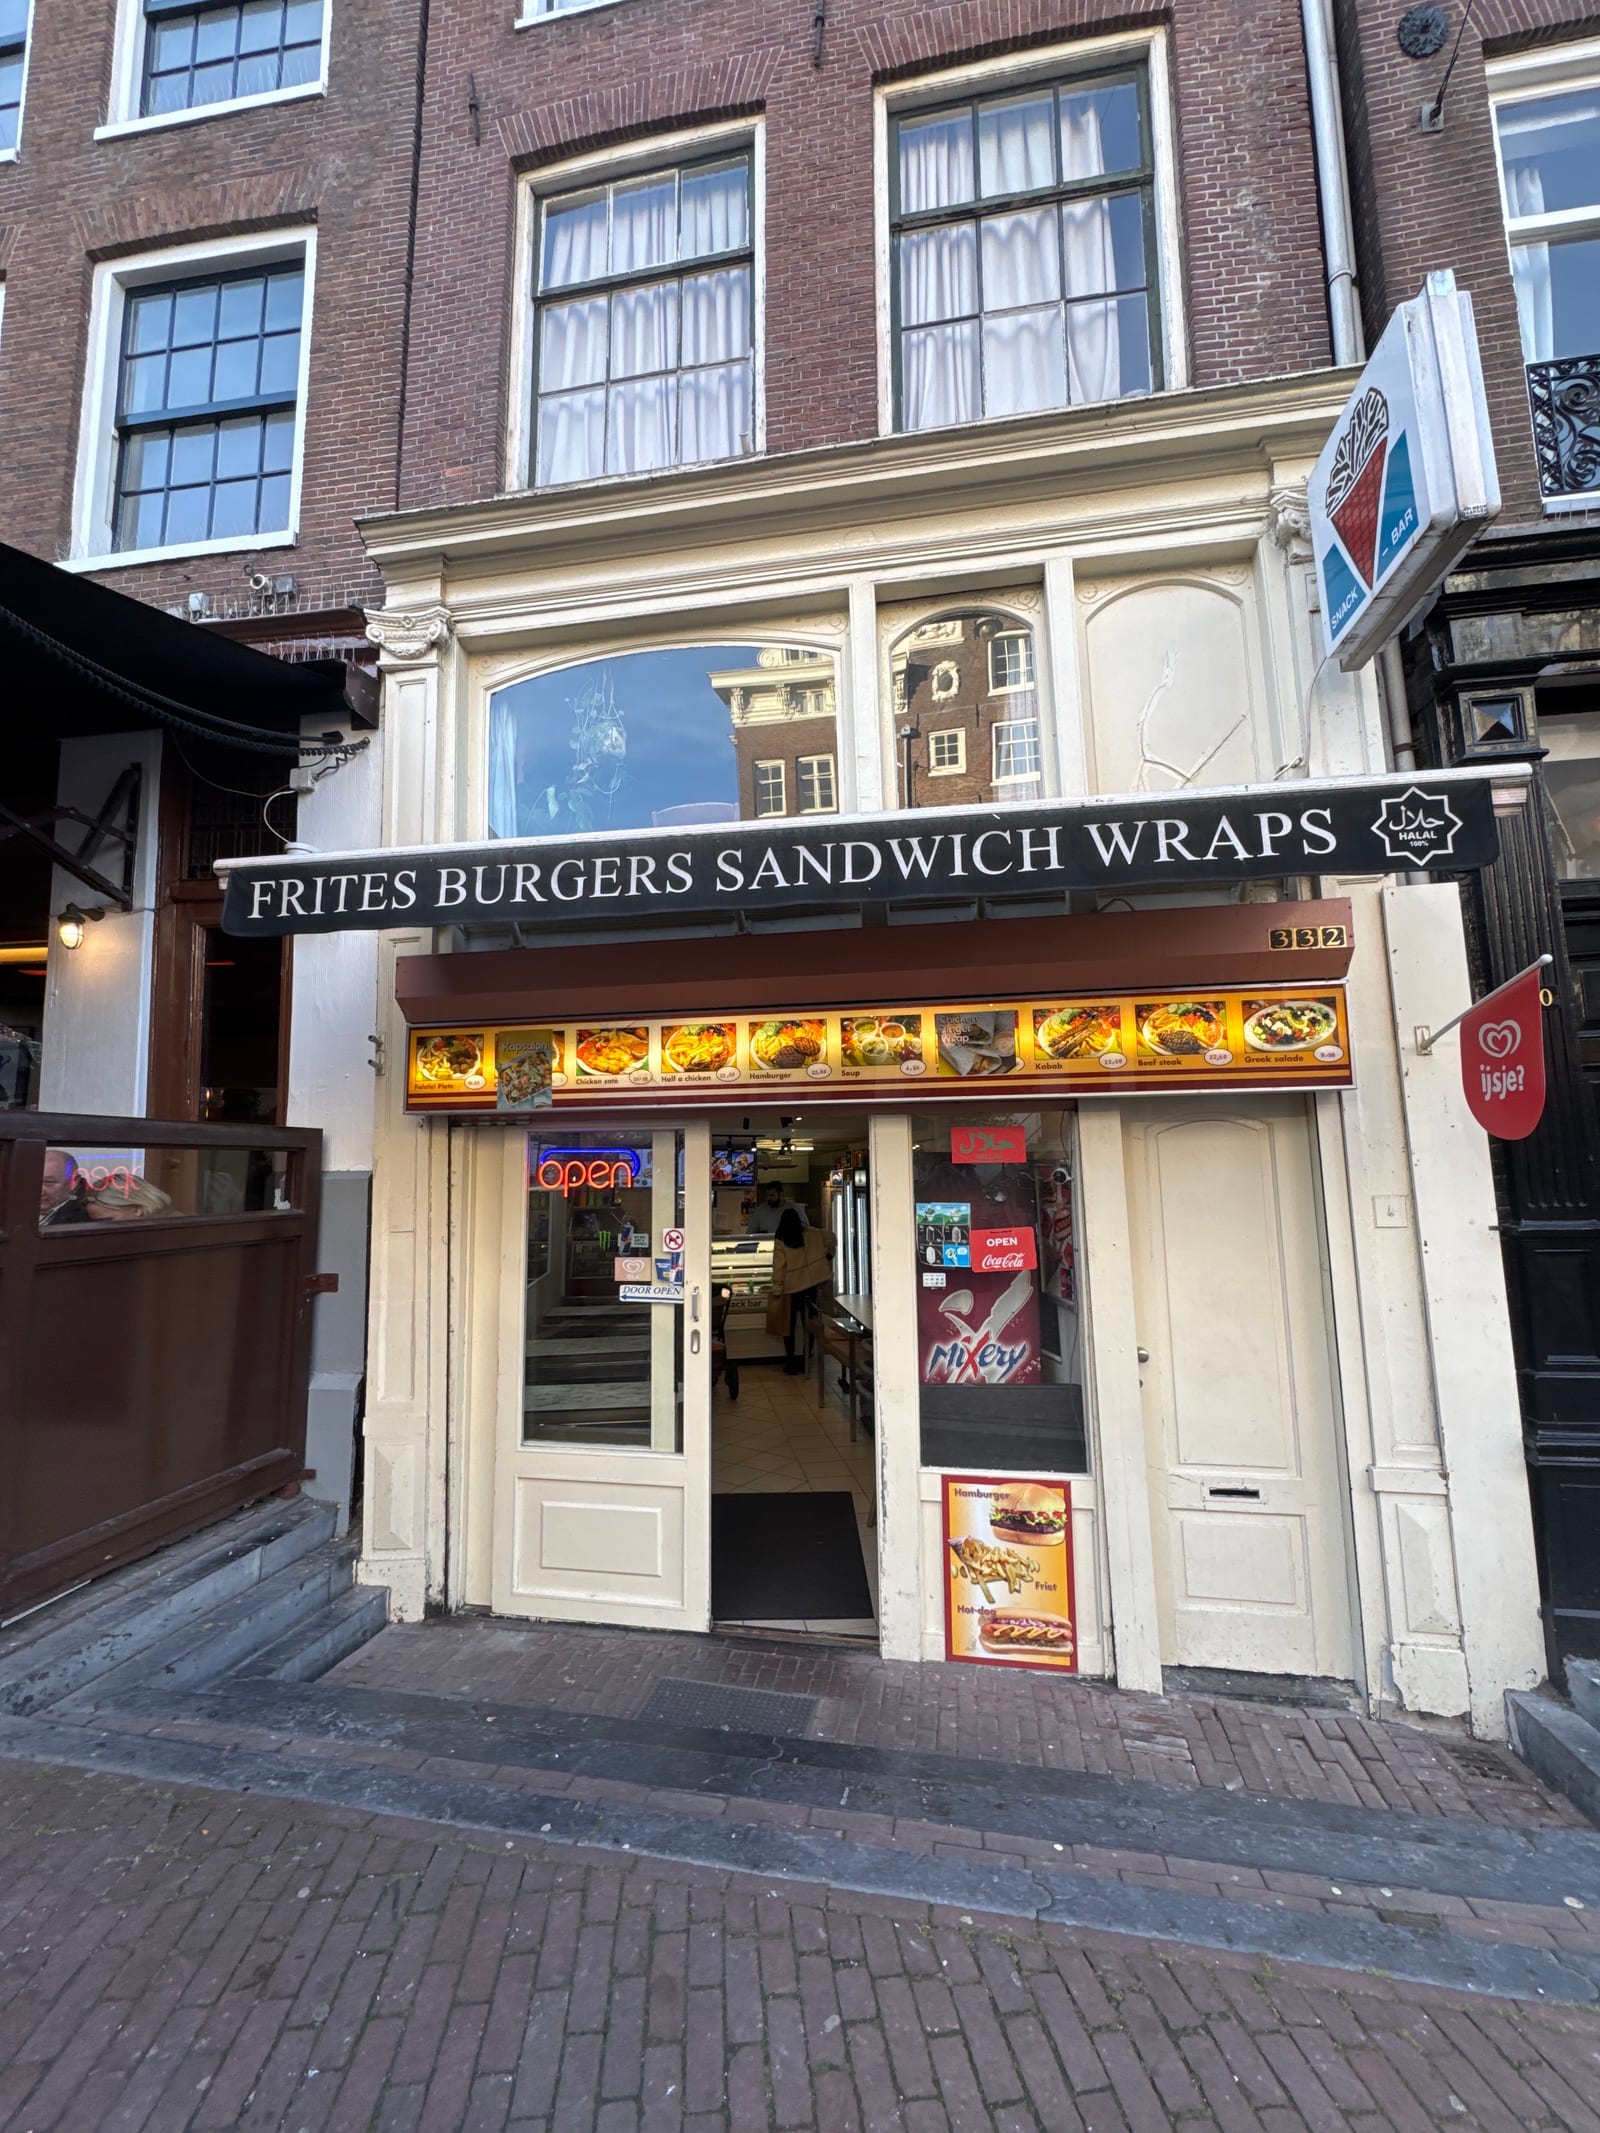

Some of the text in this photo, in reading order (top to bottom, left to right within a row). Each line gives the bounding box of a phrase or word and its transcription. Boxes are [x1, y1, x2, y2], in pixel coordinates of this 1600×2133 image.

[1330, 585, 1359, 630] SNACK
[1390, 507, 1414, 546] BAR
[1388, 804, 1445, 831] حلال
[1398, 830, 1438, 841] HALAL
[247, 808, 1338, 919] FRITES BURGERS SANDWICH WRAPS
[1273, 928, 1342, 949] 332
[941, 1033, 970, 1046] Wrap
[503, 1041, 548, 1053] Kapsalon
[1137, 1057, 1182, 1067] Beef steak
[1244, 1054, 1304, 1064] Greek salade
[661, 1075, 677, 1083] Half
[684, 1074, 712, 1082] chicken
[749, 1072, 791, 1081] Hamburger
[841, 1069, 861, 1078] Soup
[575, 1078, 603, 1086] Chicken
[1480, 1064, 1525, 1101] ijsje?
[959, 1131, 1017, 1154] حلال
[538, 1160, 633, 1198] open
[986, 1236, 1019, 1248] OPEN
[622, 1285, 681, 1296] DOOR OPEN
[953, 1487, 1011, 1500] Hamburger
[1034, 1581, 1058, 1592] Friet
[956, 1604, 997, 1617] Hot-dog
